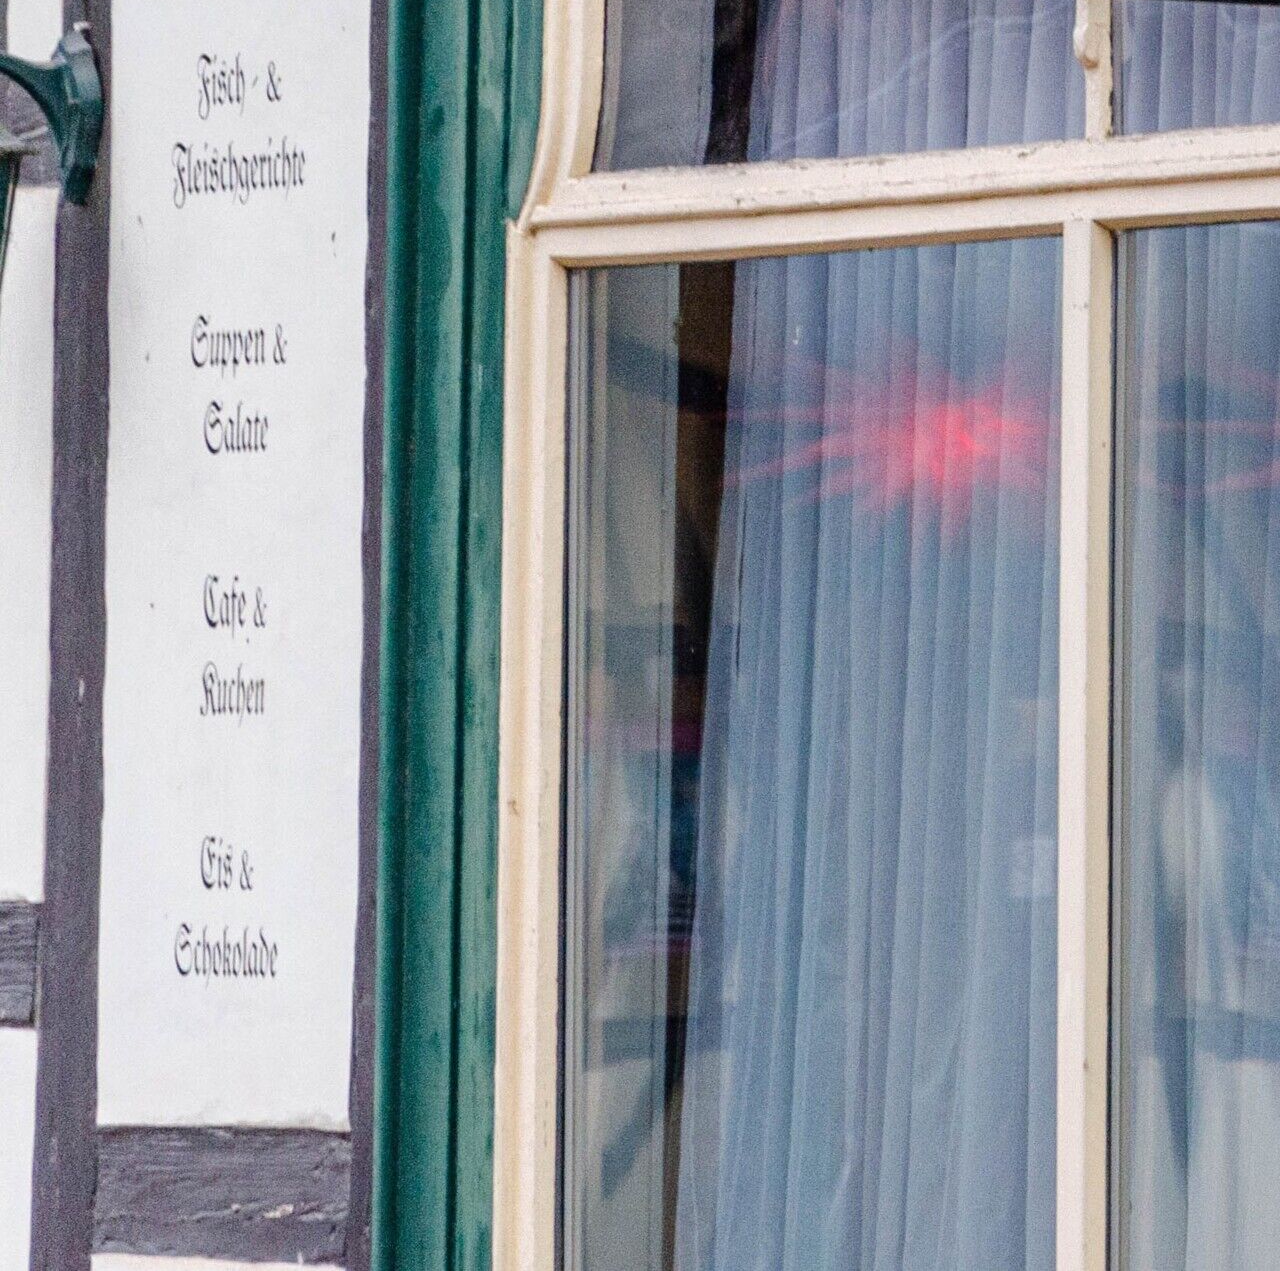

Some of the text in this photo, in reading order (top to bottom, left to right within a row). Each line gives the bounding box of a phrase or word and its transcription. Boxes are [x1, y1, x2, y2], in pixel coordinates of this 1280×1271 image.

[266, 61, 282, 102] &
[173, 136, 305, 209] Fleischgerichte
[190, 315, 287, 380] Suppen &
[203, 400, 268, 455] Salate
[253, 586, 267, 628] &
[200, 660, 265, 727] Kuchen
[200, 835, 254, 891] Eis &
[174, 923, 278, 990] Schokolade
